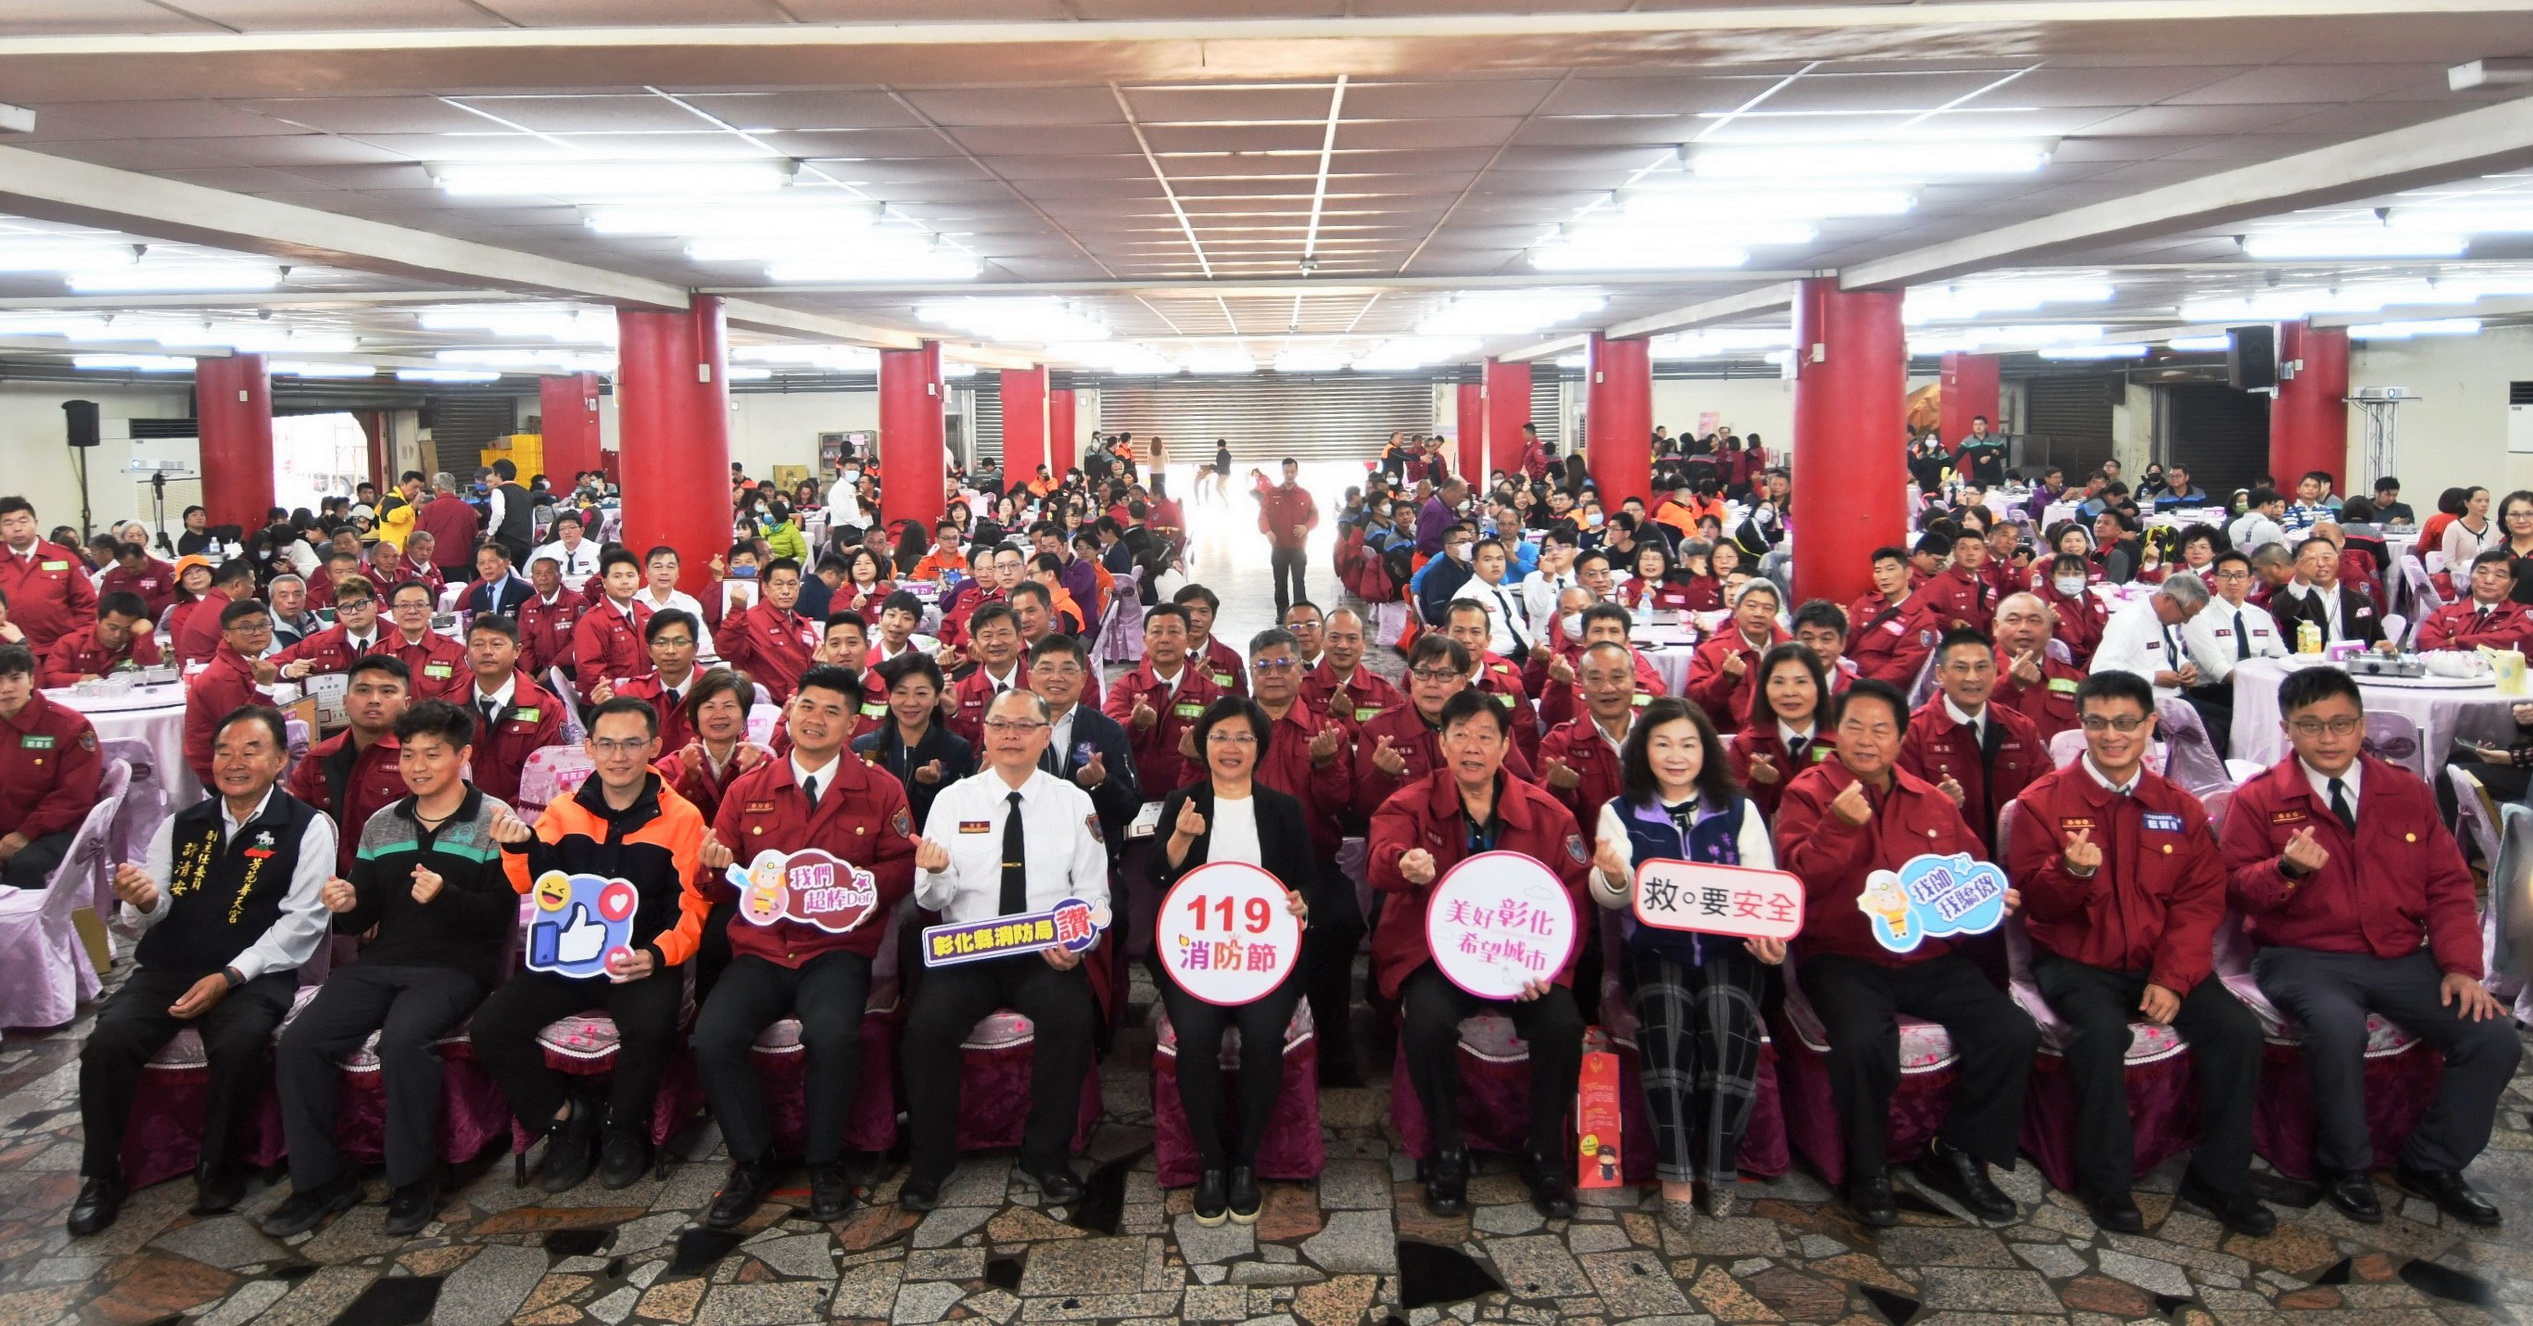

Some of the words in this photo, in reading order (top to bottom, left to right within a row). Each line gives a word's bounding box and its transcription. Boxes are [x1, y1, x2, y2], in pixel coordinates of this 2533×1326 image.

[170, 842, 199, 897] 許清安
[191, 829, 219, 891] 副主任委員
[790, 864, 833, 889] 我們
[804, 886, 873, 912] 超棒Der
[1912, 868, 1953, 902] 我帥
[1938, 873, 1999, 920] 我驕傲
[932, 919, 1054, 957] 彰化縣消防局
[1056, 904, 1092, 944] 讚
[1187, 894, 1272, 934] 119
[1445, 897, 1555, 937] 美好彰化
[1178, 939, 1277, 973] 消防節
[1457, 930, 1548, 971] 希望城市
